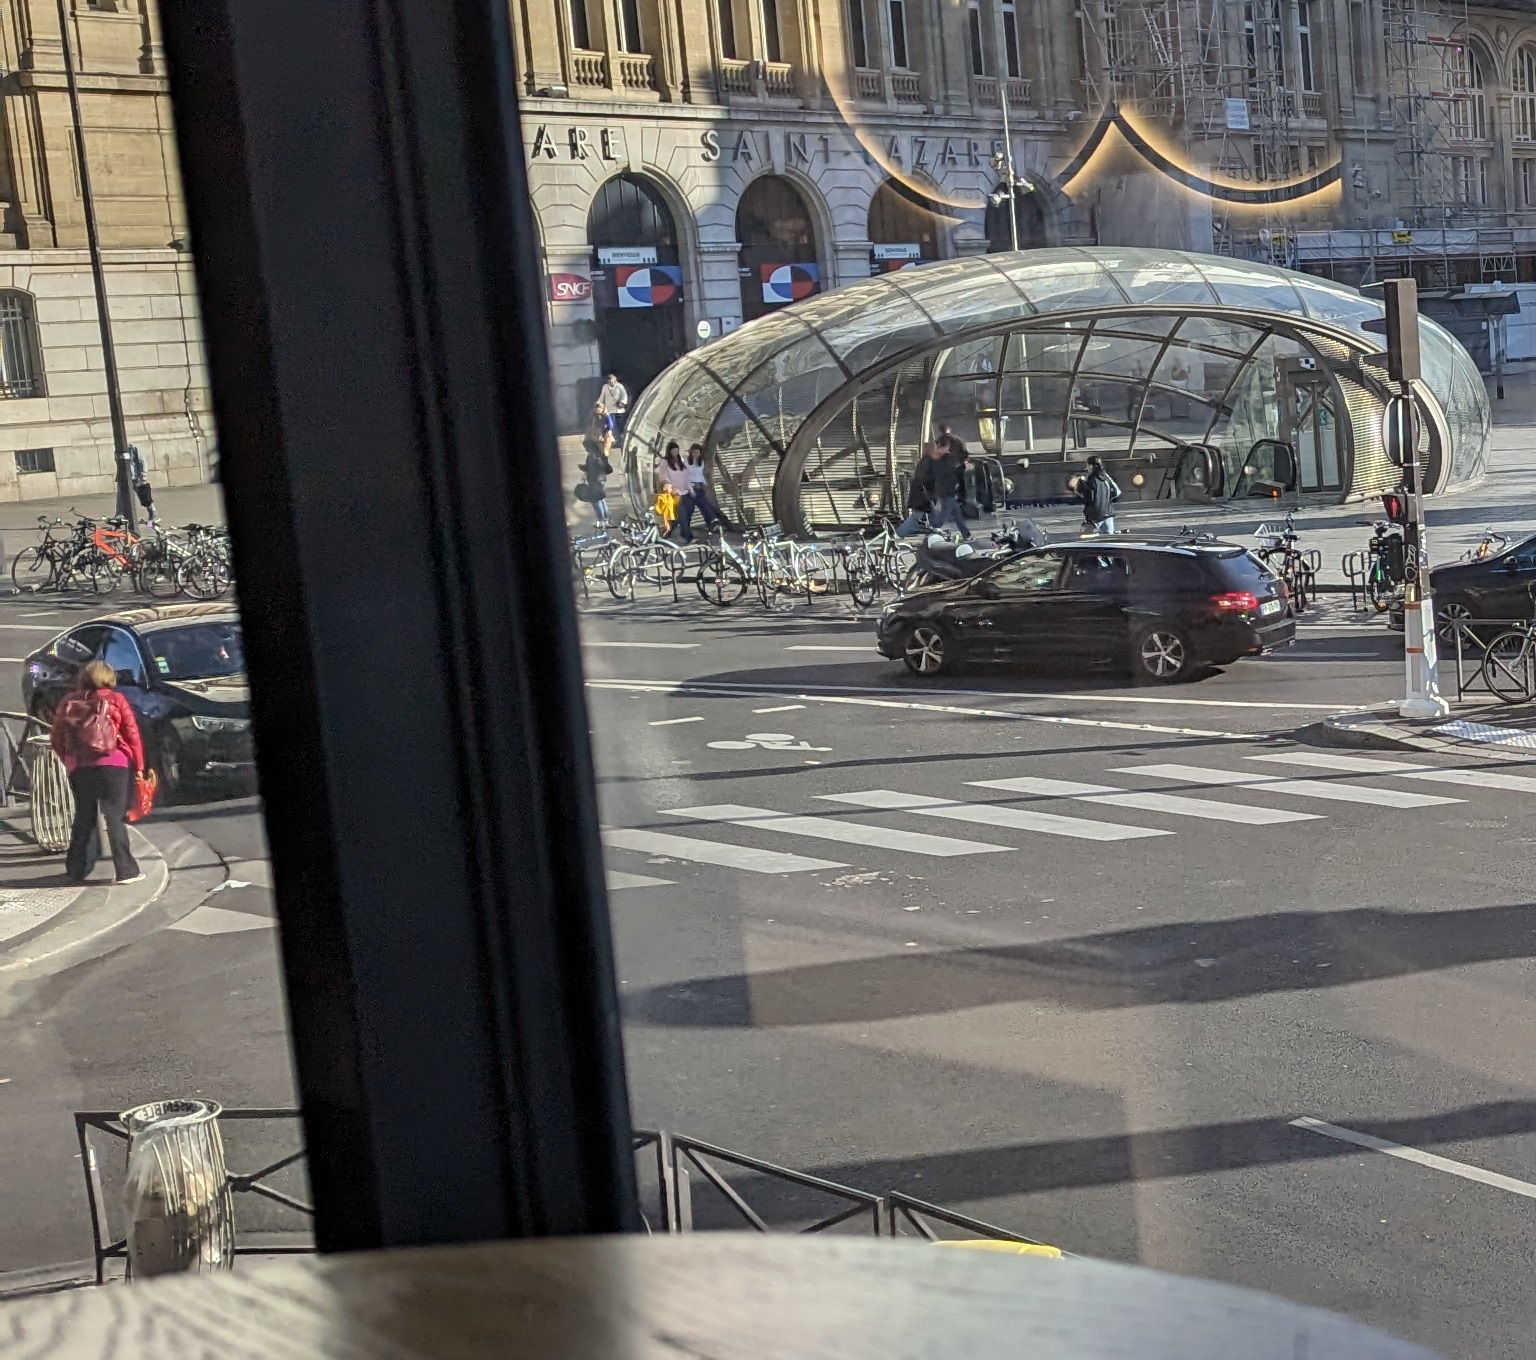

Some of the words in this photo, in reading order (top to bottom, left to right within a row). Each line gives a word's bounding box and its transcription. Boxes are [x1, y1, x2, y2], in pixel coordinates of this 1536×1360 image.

[533, 124, 622, 160] ARE
[701, 128, 831, 165] SAINT
[864, 134, 1008, 168] AZARE
[556, 282, 592, 297] SNCF
